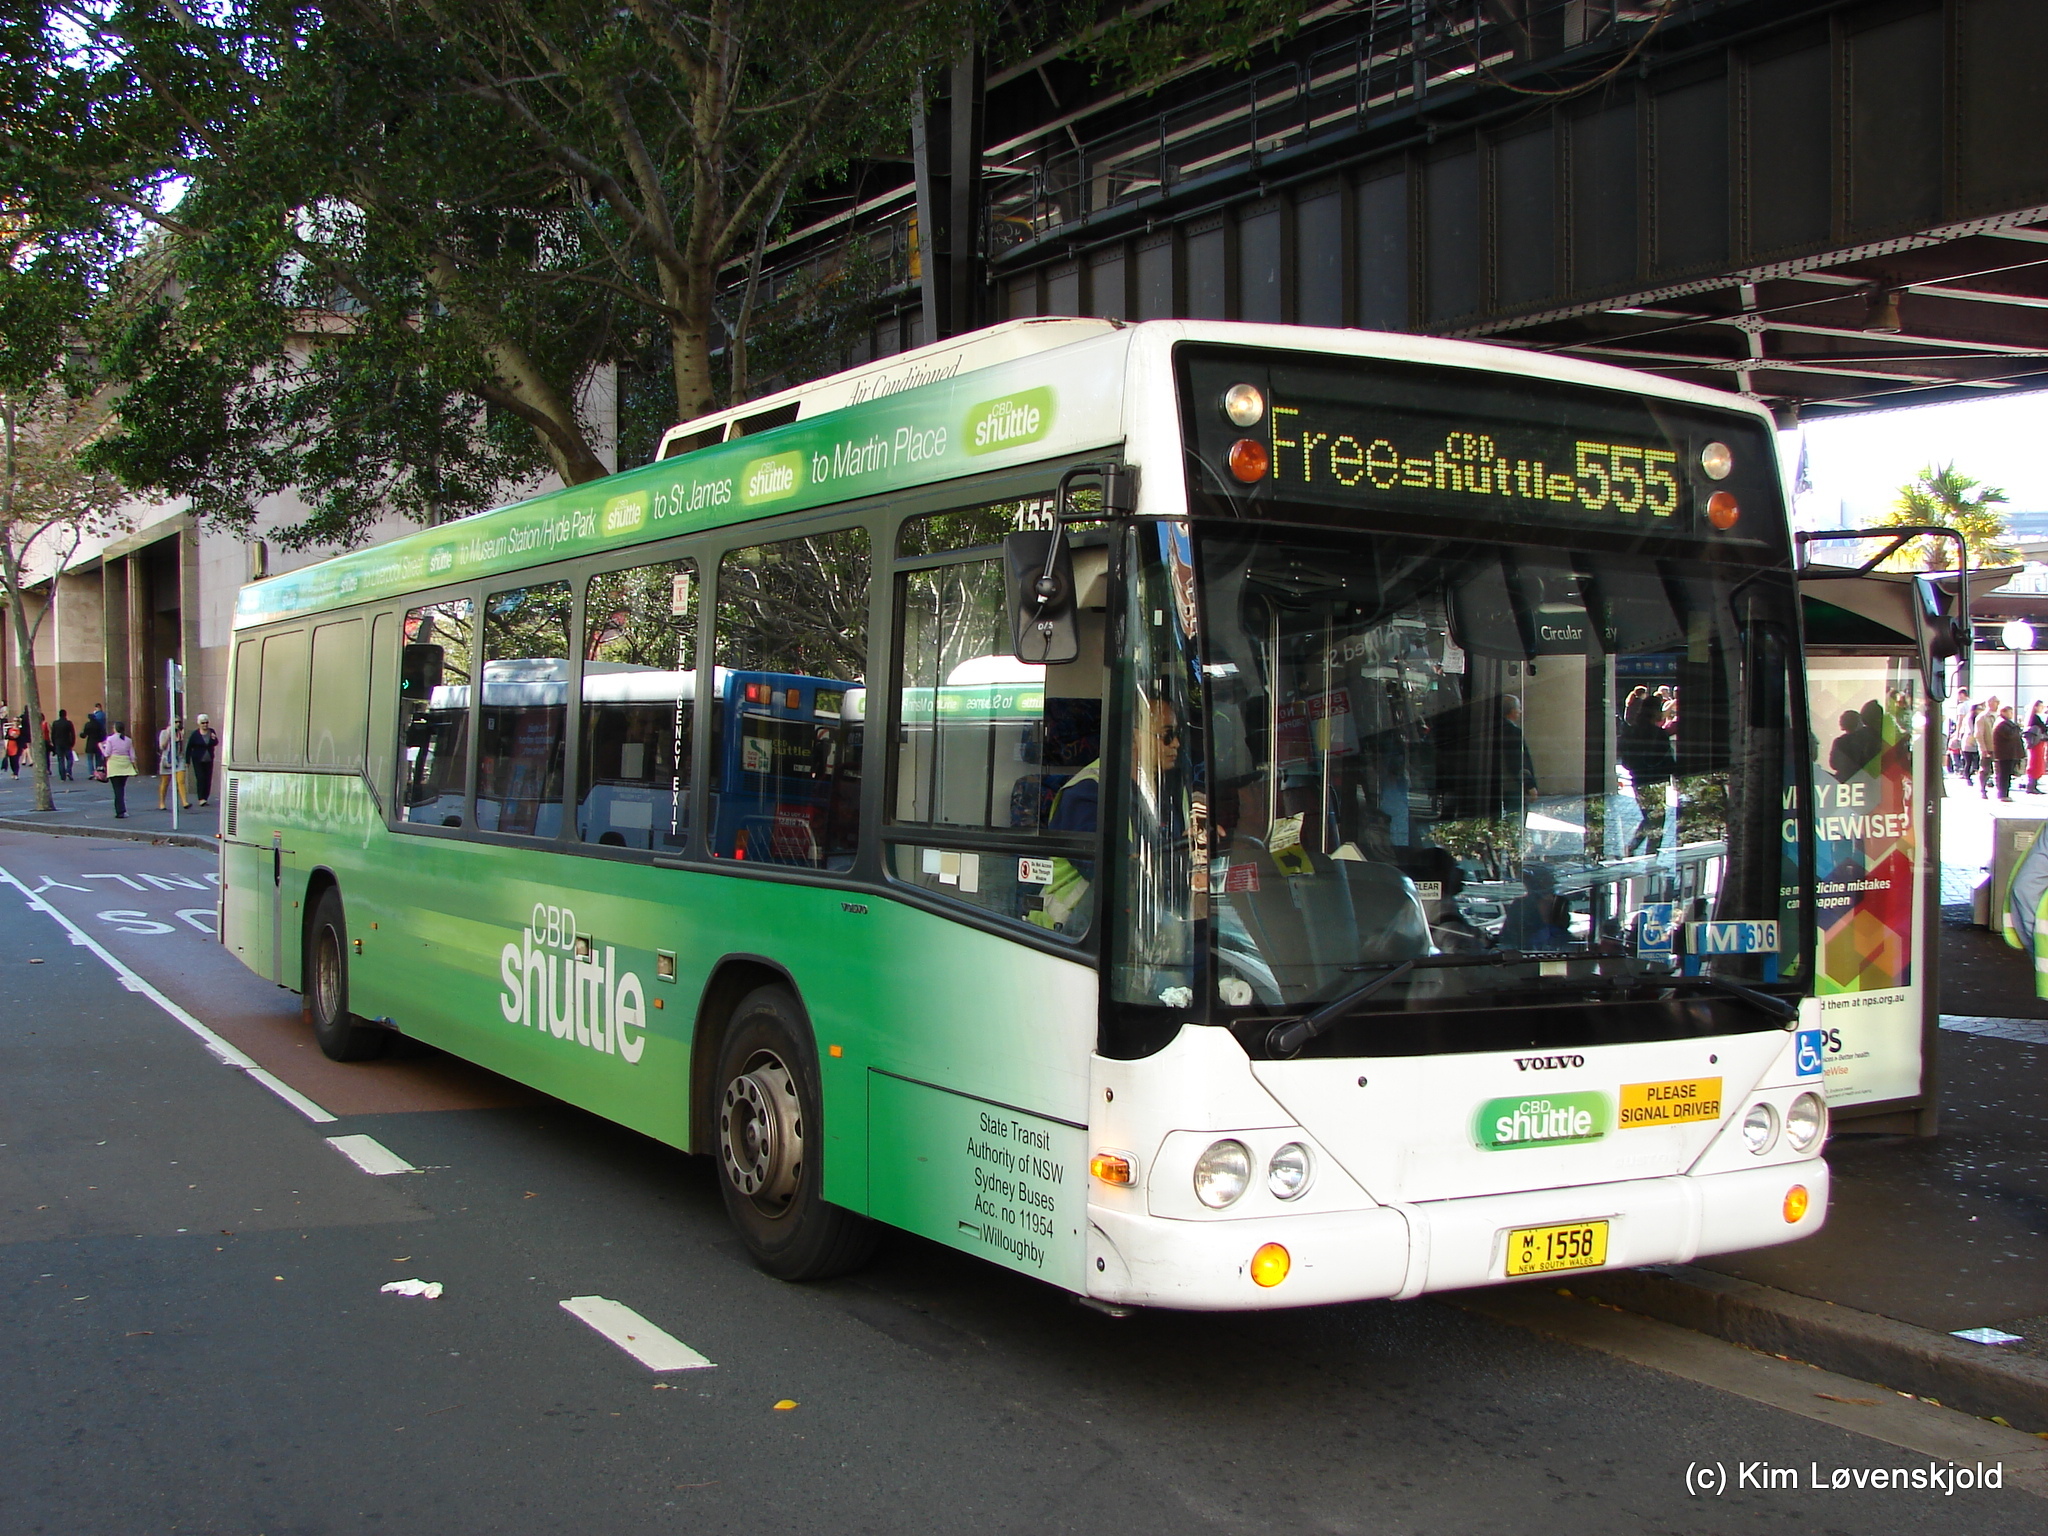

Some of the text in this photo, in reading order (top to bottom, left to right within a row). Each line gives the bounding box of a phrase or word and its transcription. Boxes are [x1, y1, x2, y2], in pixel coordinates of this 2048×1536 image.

[844, 354, 964, 409] Air Conditioned
[975, 404, 1040, 447] shuttle
[991, 400, 1013, 418] CBD
[811, 425, 947, 484] to Martin Place
[1272, 406, 1398, 489] Free
[1446, 430, 1495, 461] CBD
[749, 465, 793, 497] shuttle
[1400, 450, 1575, 503] shuttle
[1575, 440, 1678, 517] 555
[653, 478, 732, 520] to St James
[1014, 499, 1054, 531] 155
[607, 504, 642, 530] shuttle
[460, 507, 597, 565] to Museum Station/Hyde Park
[1540, 624, 1618, 642] Circular ay
[670, 634, 687, 836] EMEGENCY EXIT
[1782, 783, 1866, 810] MY BE
[1782, 813, 1910, 844] CINEWISE?
[1792, 880, 1845, 896] mdicine
[1847, 877, 1891, 893] mistakes
[1816, 896, 1851, 911] appen
[532, 902, 576, 951] CBD
[500, 927, 647, 1064] shuttle
[1827, 997, 1850, 1011] them
[1852, 998, 1861, 1009] at
[1862, 992, 1905, 1009] nps.org.au
[1821, 1027, 1842, 1054] PS
[1514, 1054, 1585, 1071] VOLVO
[1519, 1099, 1551, 1115] CBD
[1647, 1084, 1697, 1102] PLEASE
[1495, 1105, 1592, 1142] shuttle
[1621, 1100, 1720, 1123] SIGNAL DRIVER
[980, 1112, 1050, 1151] State Transit
[967, 1137, 1064, 1185] Authority of NSW
[974, 1167, 1055, 1212] Sydney Buses
[974, 1193, 1054, 1239] Acc. no 11954
[983, 1222, 1045, 1269] Willoughby
[1546, 1228, 1594, 1261] 1558
[1518, 1256, 1594, 1273] NEW SOUTH WALES
